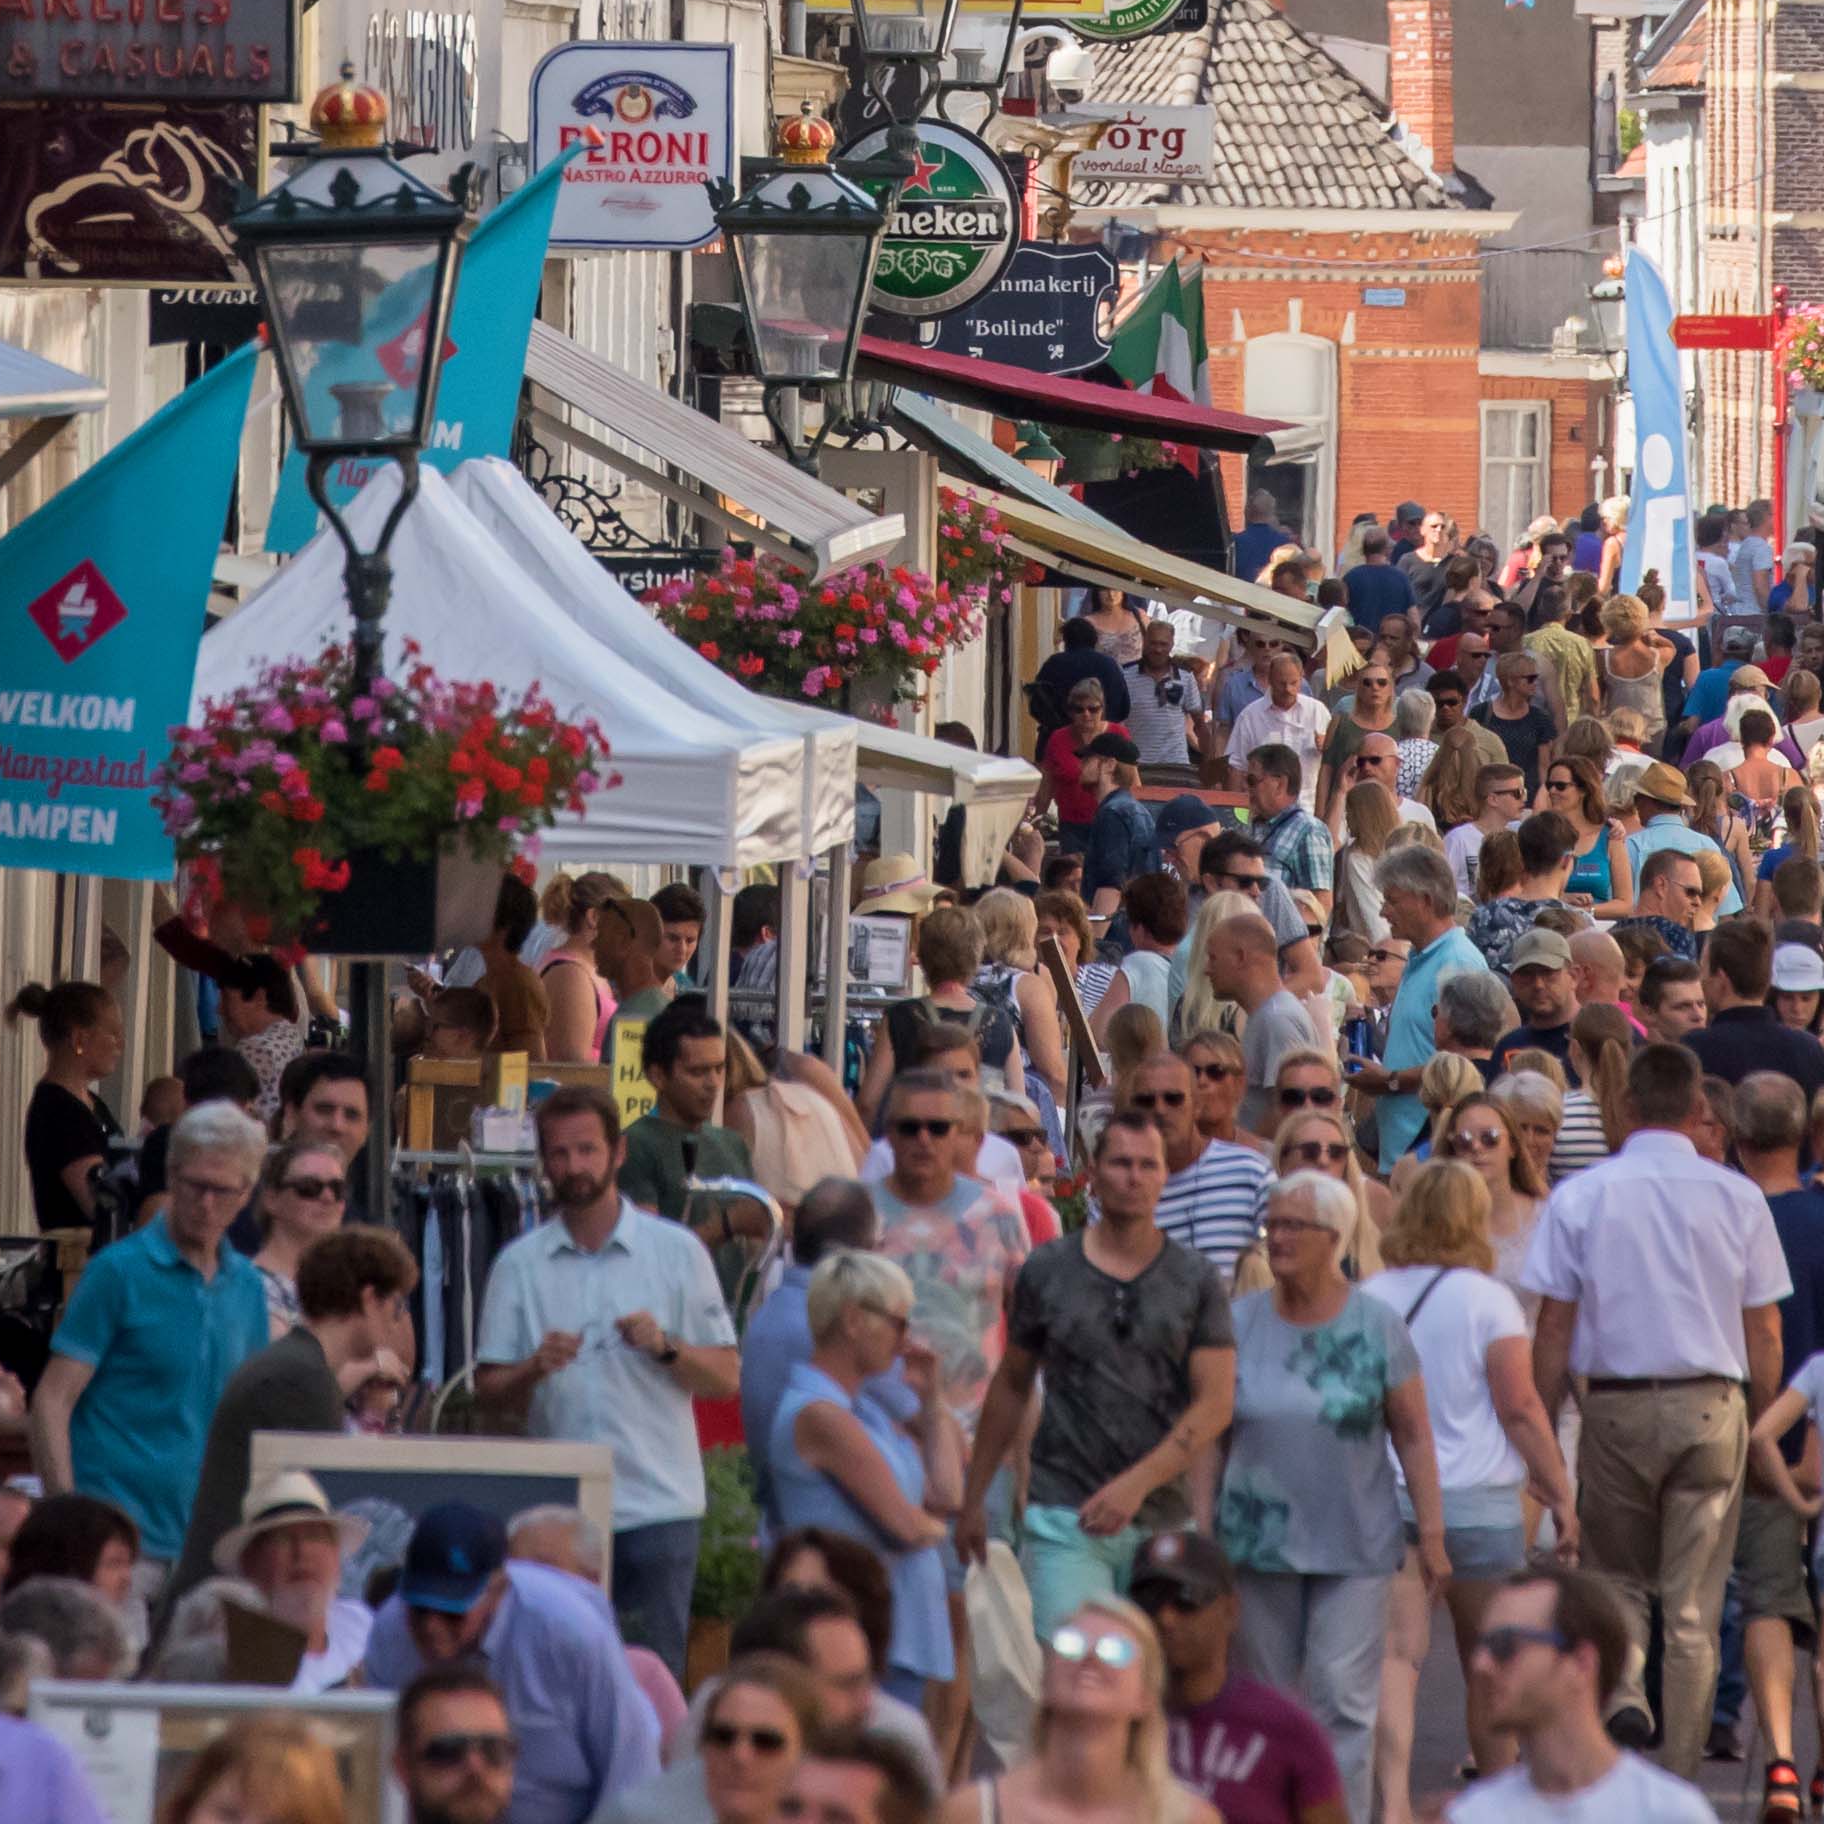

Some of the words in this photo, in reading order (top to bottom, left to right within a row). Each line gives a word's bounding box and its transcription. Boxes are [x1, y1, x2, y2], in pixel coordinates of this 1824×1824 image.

[58, 41, 273, 82] CASUALS
[562, 168, 626, 184] NASTRO
[629, 168, 709, 185] AZZURRO
[886, 205, 998, 237] neken
[991, 276, 1096, 297] nmakerij
